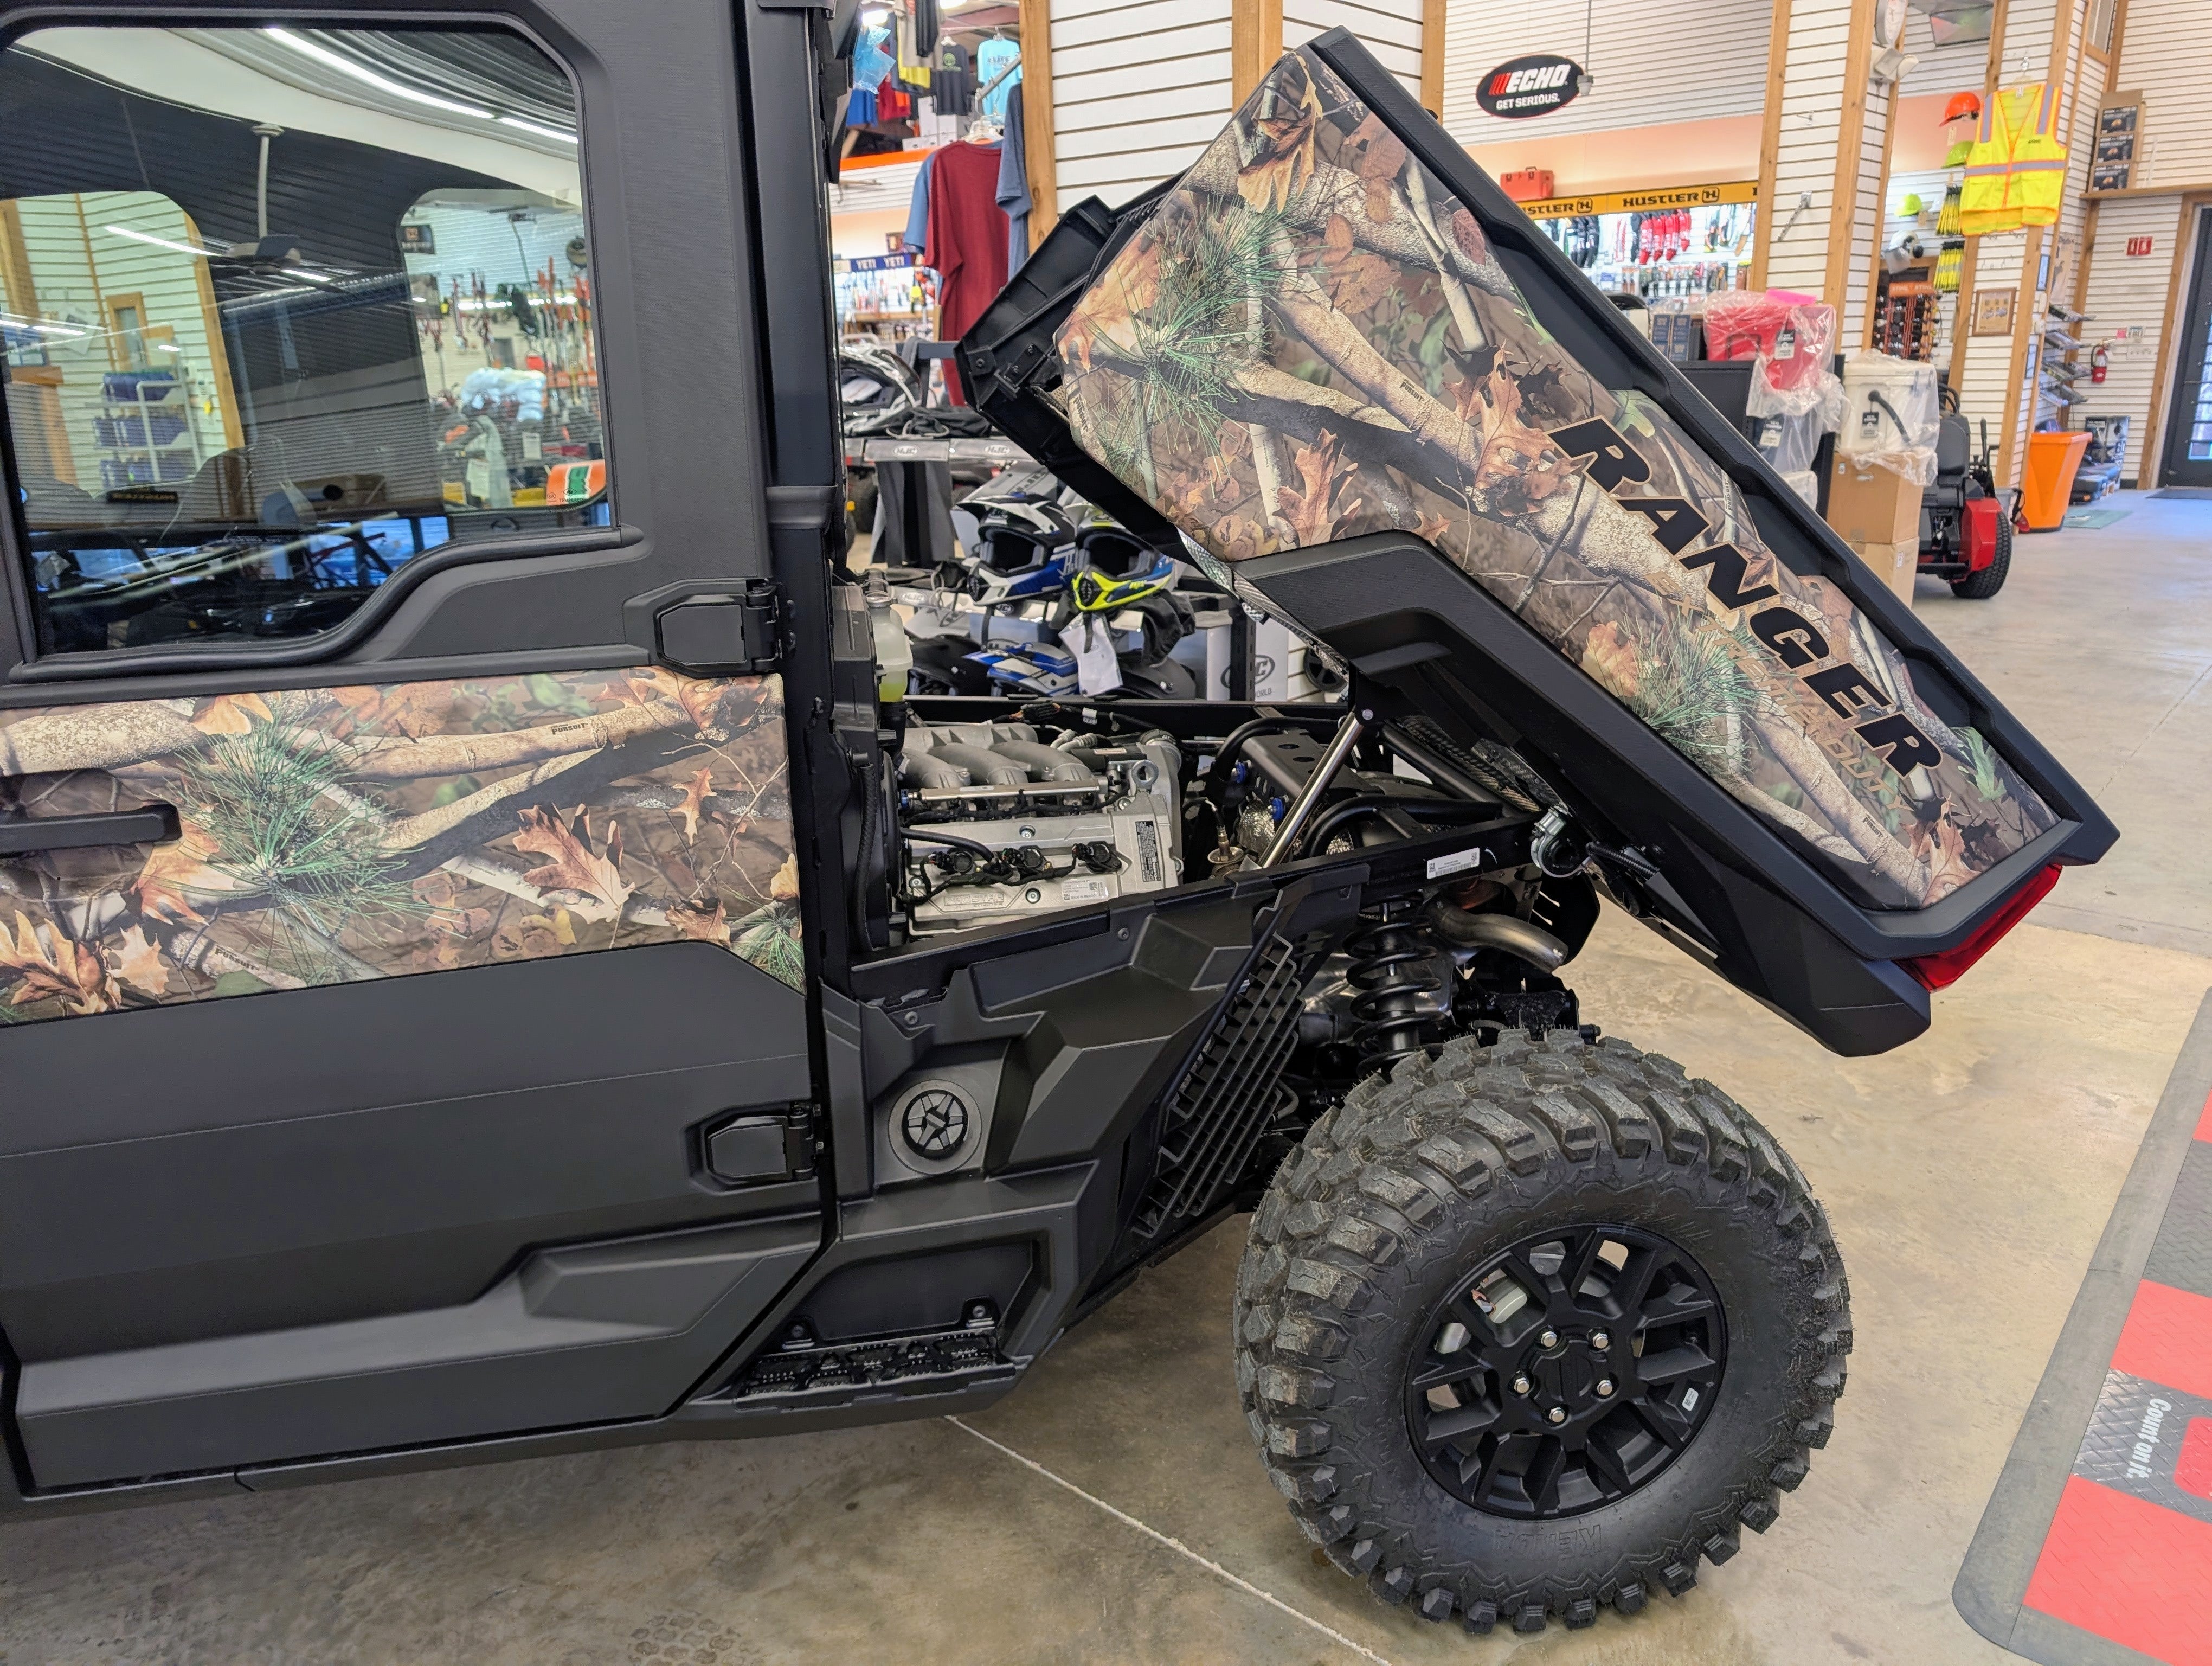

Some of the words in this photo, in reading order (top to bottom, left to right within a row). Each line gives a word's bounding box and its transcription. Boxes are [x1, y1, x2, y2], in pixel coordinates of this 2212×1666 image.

[1506, 64, 1571, 94] ECHO
[1496, 98, 1514, 111] GET
[1522, 203, 1573, 214] STLER
[1623, 192, 1699, 207] HUSTLER
[856, 259, 876, 269] YETI
[884, 256, 904, 266] YETI
[1399, 381, 1425, 402] PURSUIT
[1073, 396, 1089, 432] PURSUIT
[896, 446, 917, 455] HJC
[987, 445, 1007, 454] HJC
[1543, 415, 1944, 779] RANGER
[1256, 687, 1272, 697] ORLD
[1644, 571, 1819, 727] EXTREME
[1819, 737, 1915, 812] DUTY
[551, 723, 587, 735] PURSUIT
[1862, 816, 1884, 838] PURSUIT
[944, 892, 1004, 905] PROSTAR
[215, 947, 259, 971] PURSUIT
[2138, 1398, 2172, 1443] Count
[2132, 1442, 2153, 1463] on
[2126, 1460, 2153, 1478] it.
[1492, 1523, 1602, 1560] KENDA
